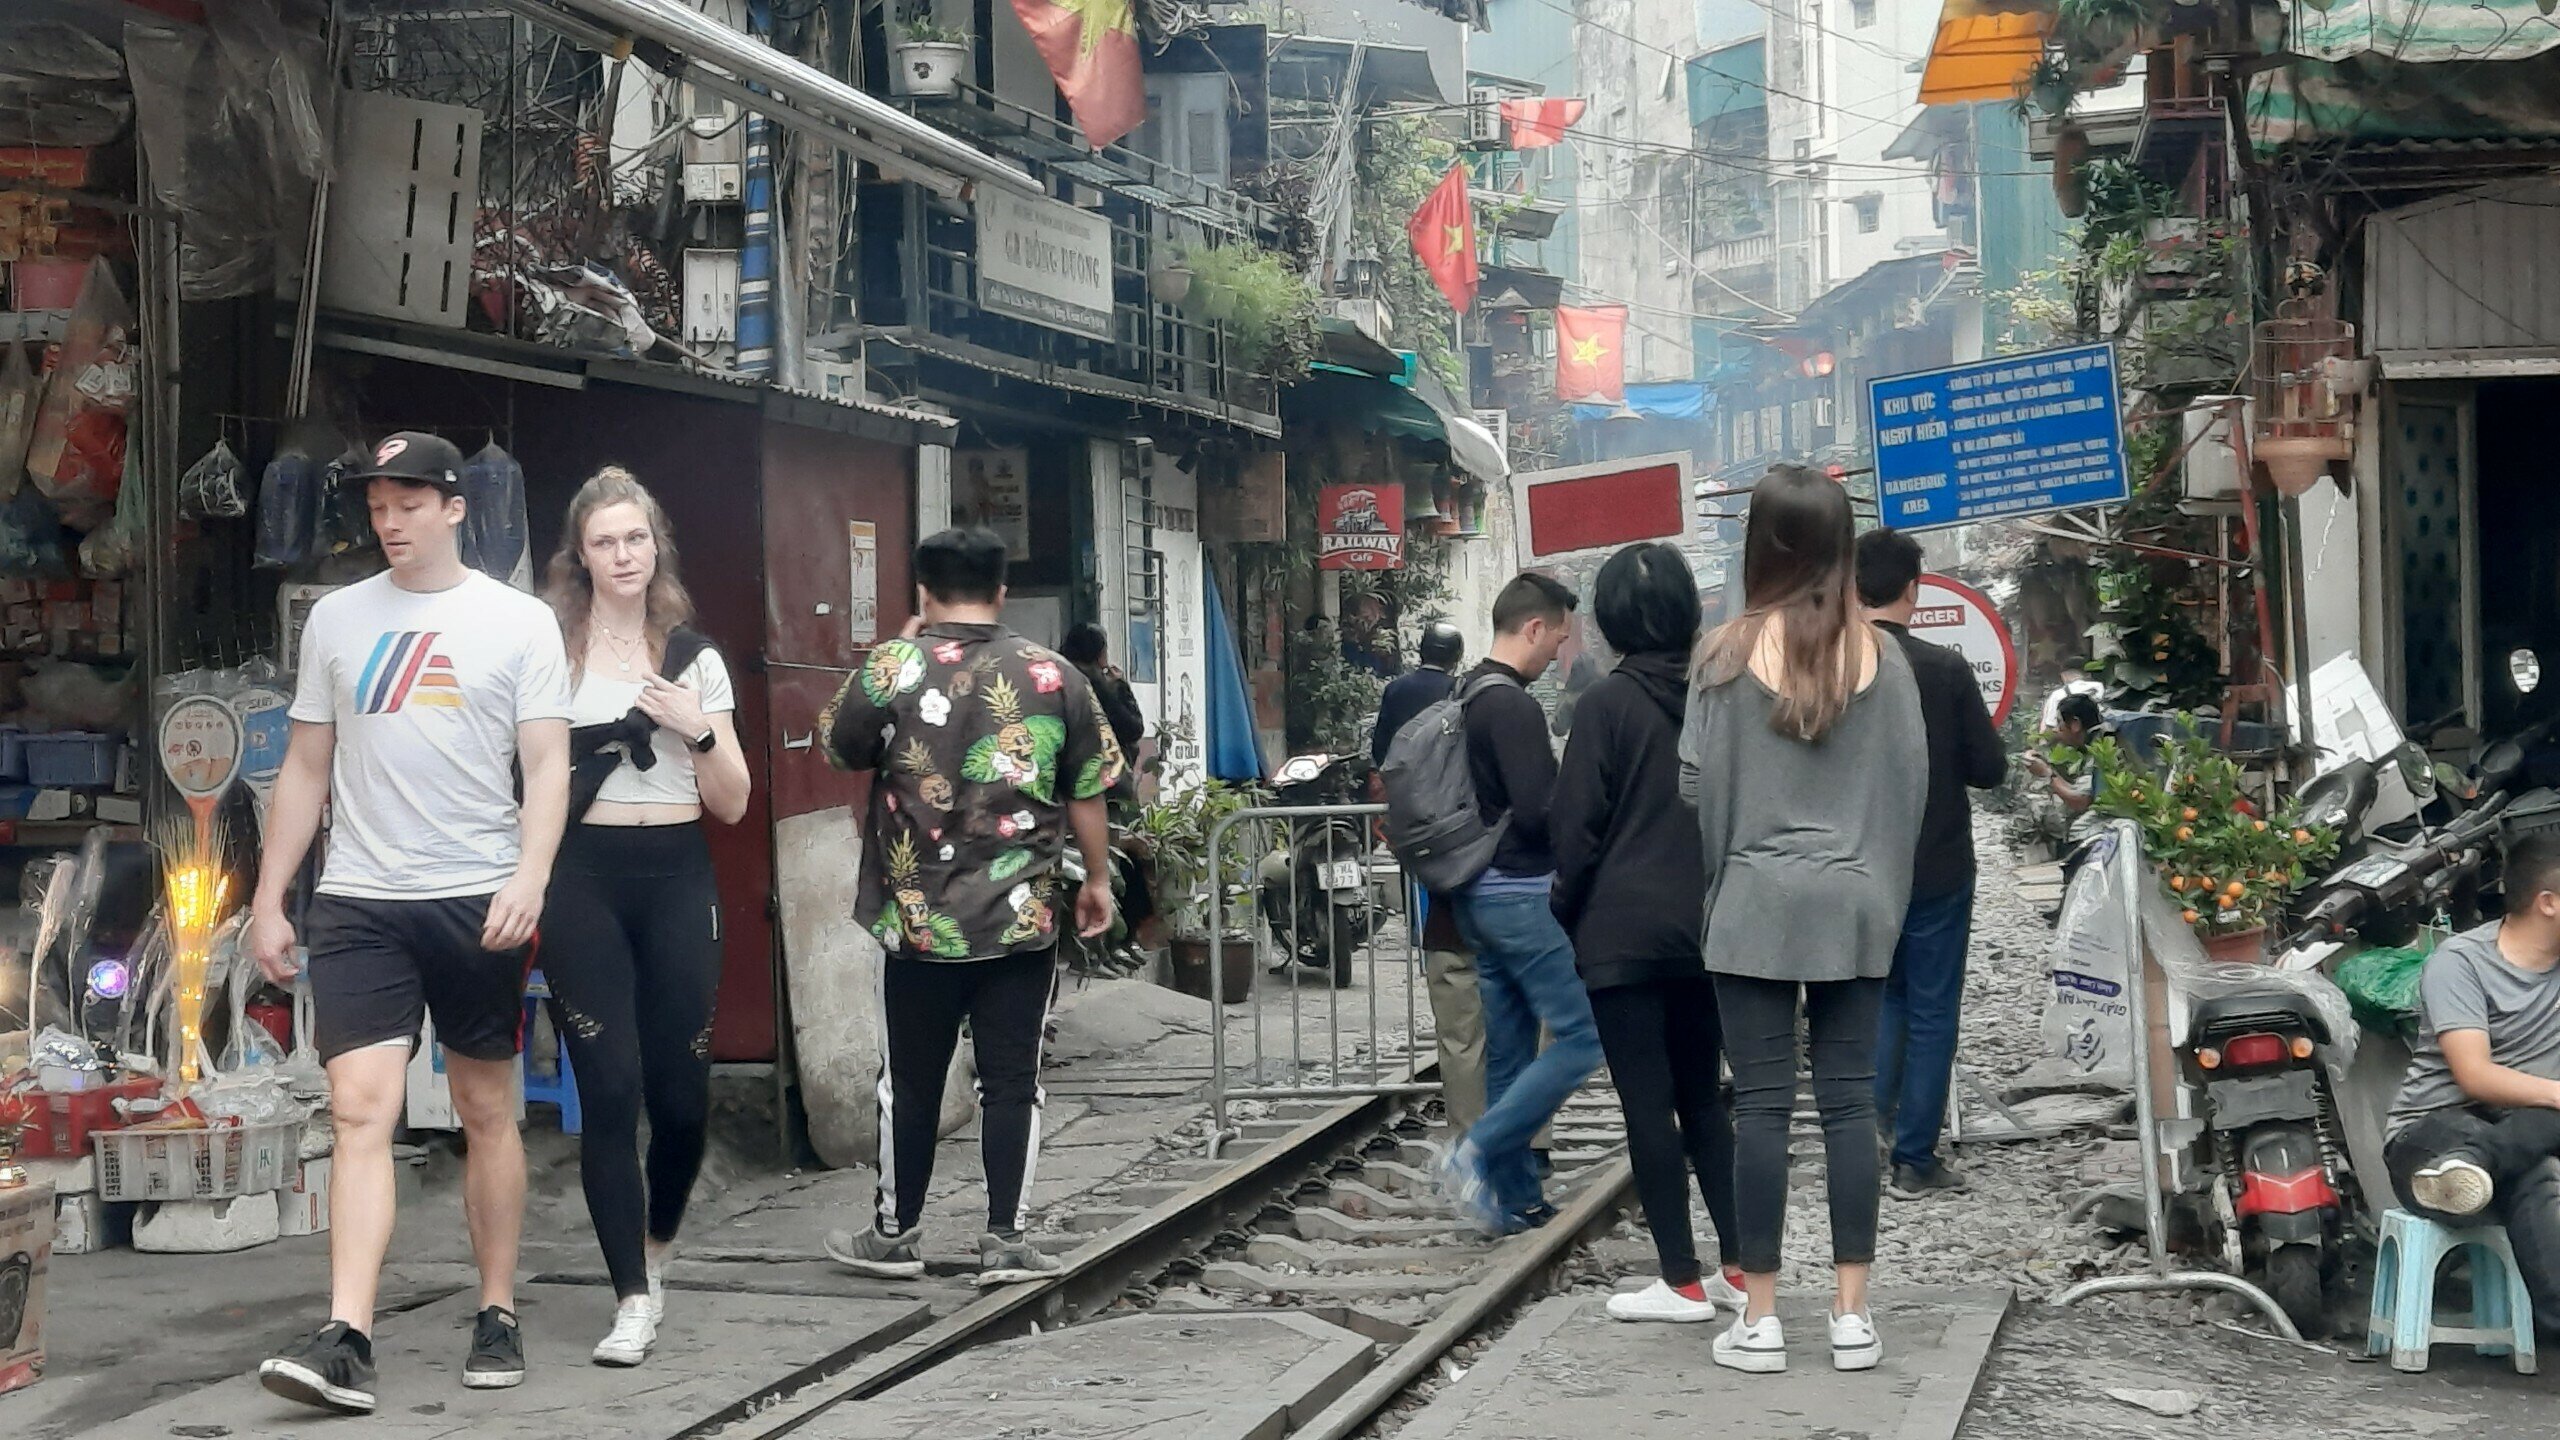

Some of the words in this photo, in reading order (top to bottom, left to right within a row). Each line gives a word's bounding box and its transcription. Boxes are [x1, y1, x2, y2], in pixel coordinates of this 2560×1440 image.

[1883, 397, 1909, 416] KHU
[1885, 473, 1948, 495] DANGEROUS
[1903, 498, 1930, 515] AREA
[1321, 536, 1400, 554] RAILWAY
[1910, 609, 1958, 625] NGER
